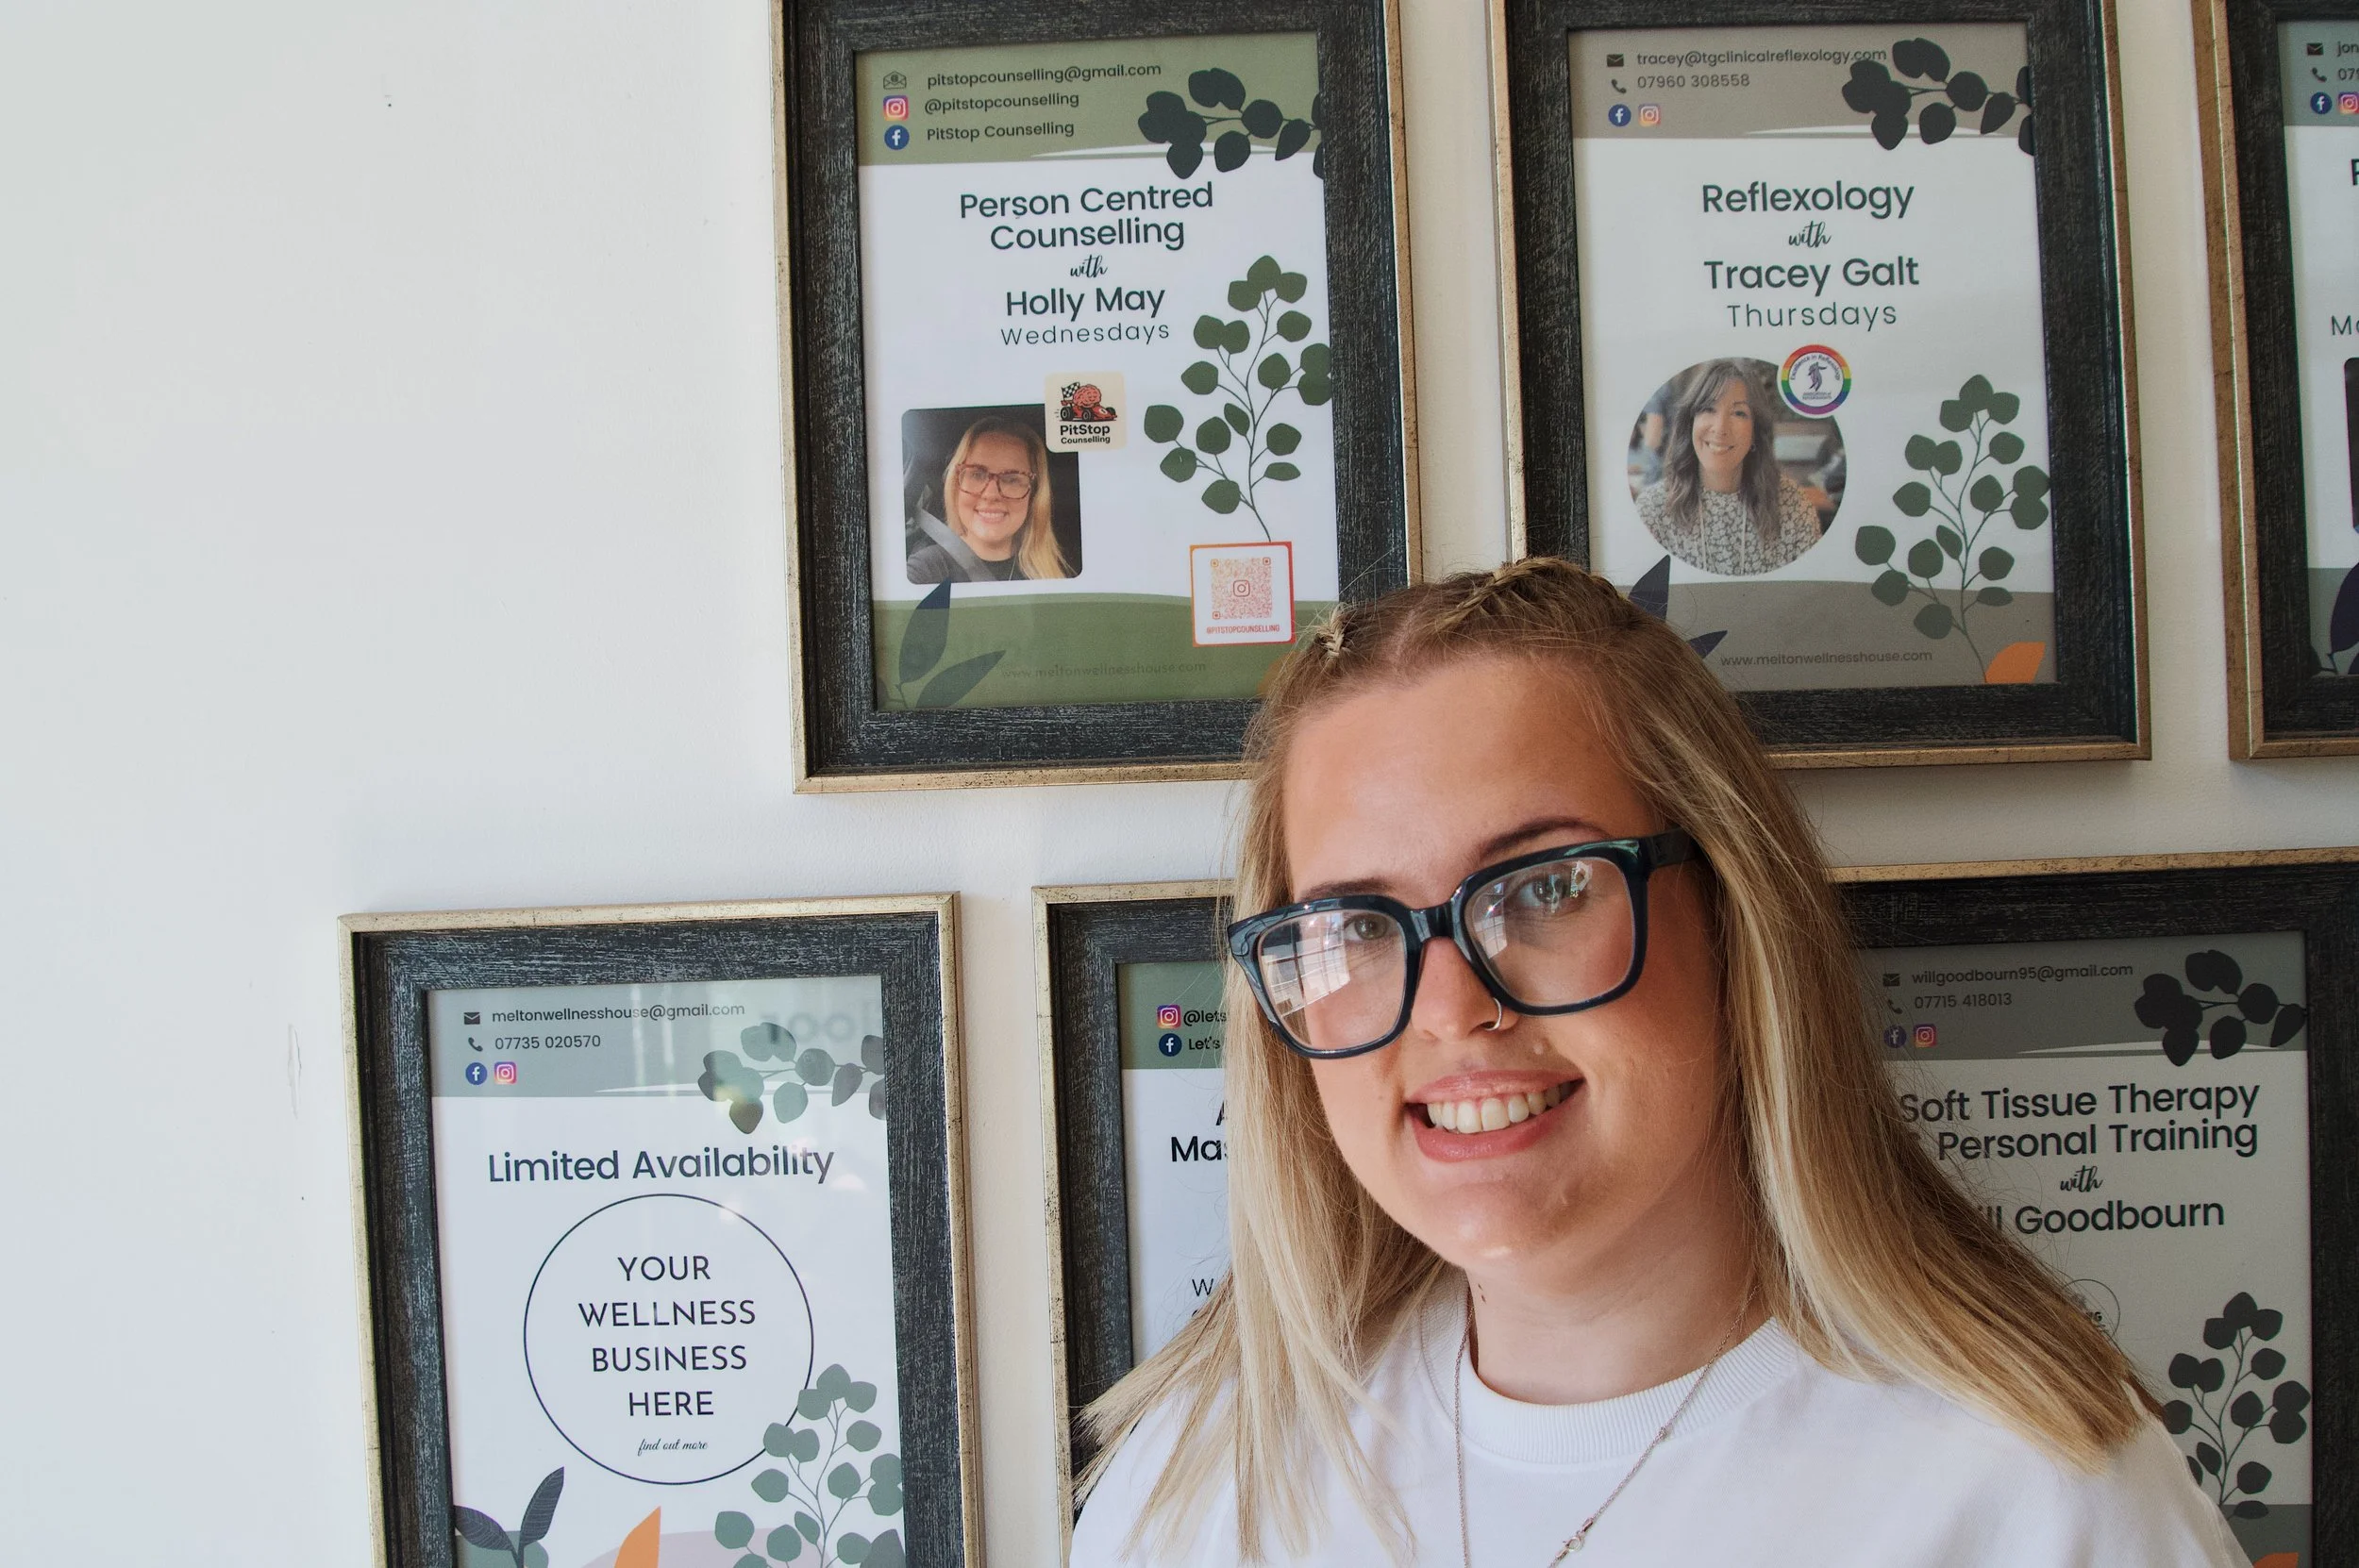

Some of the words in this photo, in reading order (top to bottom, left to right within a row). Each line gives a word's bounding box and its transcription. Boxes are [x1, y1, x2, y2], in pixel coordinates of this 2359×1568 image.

[1636, 48, 1887, 68] tracey@tgclinicalreflexology.com
[928, 62, 1162, 89] pitstopcounselling@gmail.com
[1637, 75, 1686, 89] 07960
[1691, 73, 1750, 88] 308558
[925, 92, 1079, 115] @pitstopcounselling
[927, 125, 980, 142] PitStop
[984, 121, 1075, 138] Counselling
[960, 192, 1070, 219] Person
[1079, 180, 1213, 213] Centred
[1702, 180, 1915, 220] Reflexology
[990, 217, 1185, 252] Counselling
[1788, 220, 1832, 248] with
[1070, 254, 1108, 278] with
[1703, 260, 1831, 297] Tracey
[1842, 256, 1920, 287] Galt
[1006, 288, 1084, 323] Holly
[1096, 286, 1165, 316] May
[1727, 301, 1897, 332] Thursdays
[1000, 323, 1170, 346] Wednesdays
[1060, 424, 1111, 437] PitStop
[1061, 435, 1111, 444] Counselling
[1205, 624, 1280, 635] @PITSTOPCOUNSELLING
[1719, 649, 1932, 667] www.meltonwellnesshouse.com
[1912, 964, 2133, 987] willgoodbourn95@gmail.com
[492, 1003, 745, 1023] meltonwellnesshouse@gmail.com
[1914, 994, 1957, 1009] 07715
[1962, 992, 2013, 1007] 418013
[494, 1036, 540, 1050] 07735
[544, 1034, 601, 1049] 020570
[1899, 1089, 1971, 1124] Soft
[1981, 1087, 2098, 1120] Tissue
[2108, 1082, 2261, 1119] Therapy
[1171, 1136, 1230, 1162] Ma
[1937, 1123, 2097, 1161] Personal
[2108, 1118, 2258, 1159] Training
[489, 1149, 619, 1182] Limited
[632, 1144, 834, 1184] Availability
[2059, 1164, 2103, 1193] with
[2015, 1199, 2224, 1235] Goodbourn
[617, 1255, 711, 1282] YOUR
[577, 1299, 756, 1327] WELLNESS
[592, 1344, 747, 1373] BUSINESS
[628, 1391, 714, 1416] HERE
[637, 1438, 661, 1457] find
[662, 1438, 680, 1450] out
[682, 1441, 708, 1450] more
